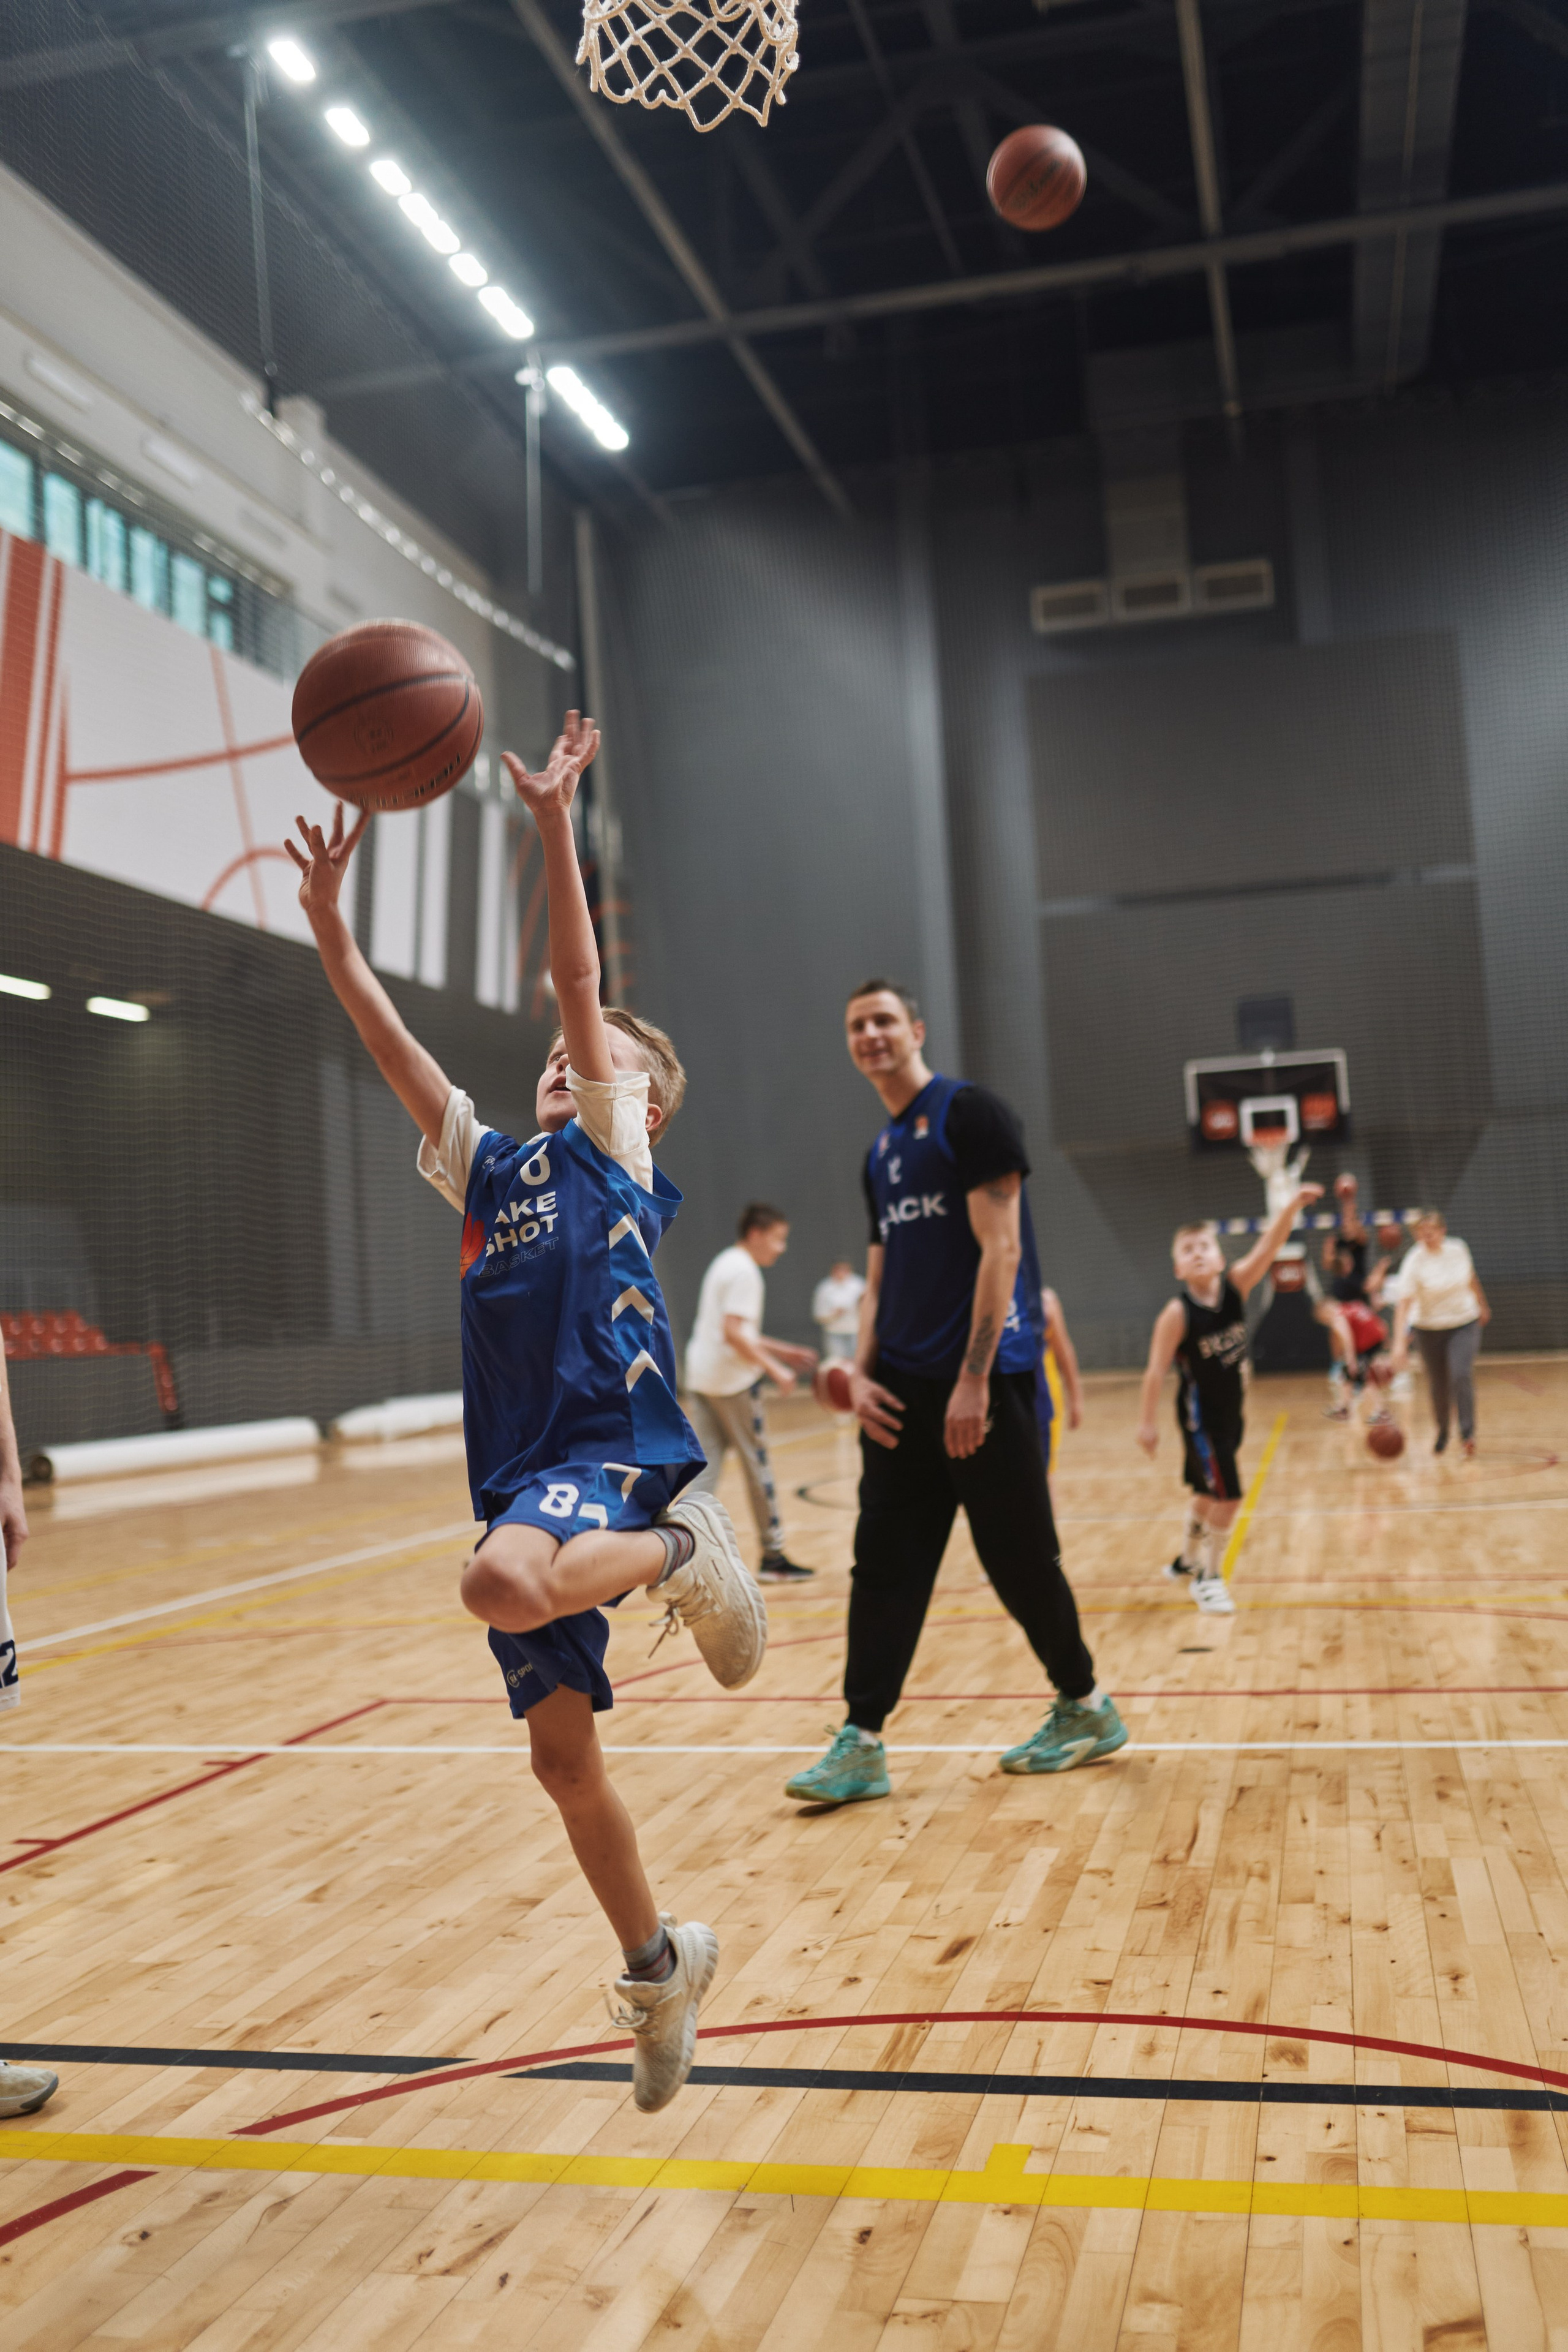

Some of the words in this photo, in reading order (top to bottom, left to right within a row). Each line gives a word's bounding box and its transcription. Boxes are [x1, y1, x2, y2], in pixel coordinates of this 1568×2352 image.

[494, 1191, 556, 1224] AKE
[486, 1212, 558, 1257] SHOT
[479, 1237, 559, 1278] BASKET
[0, 1639, 18, 1689] 2
